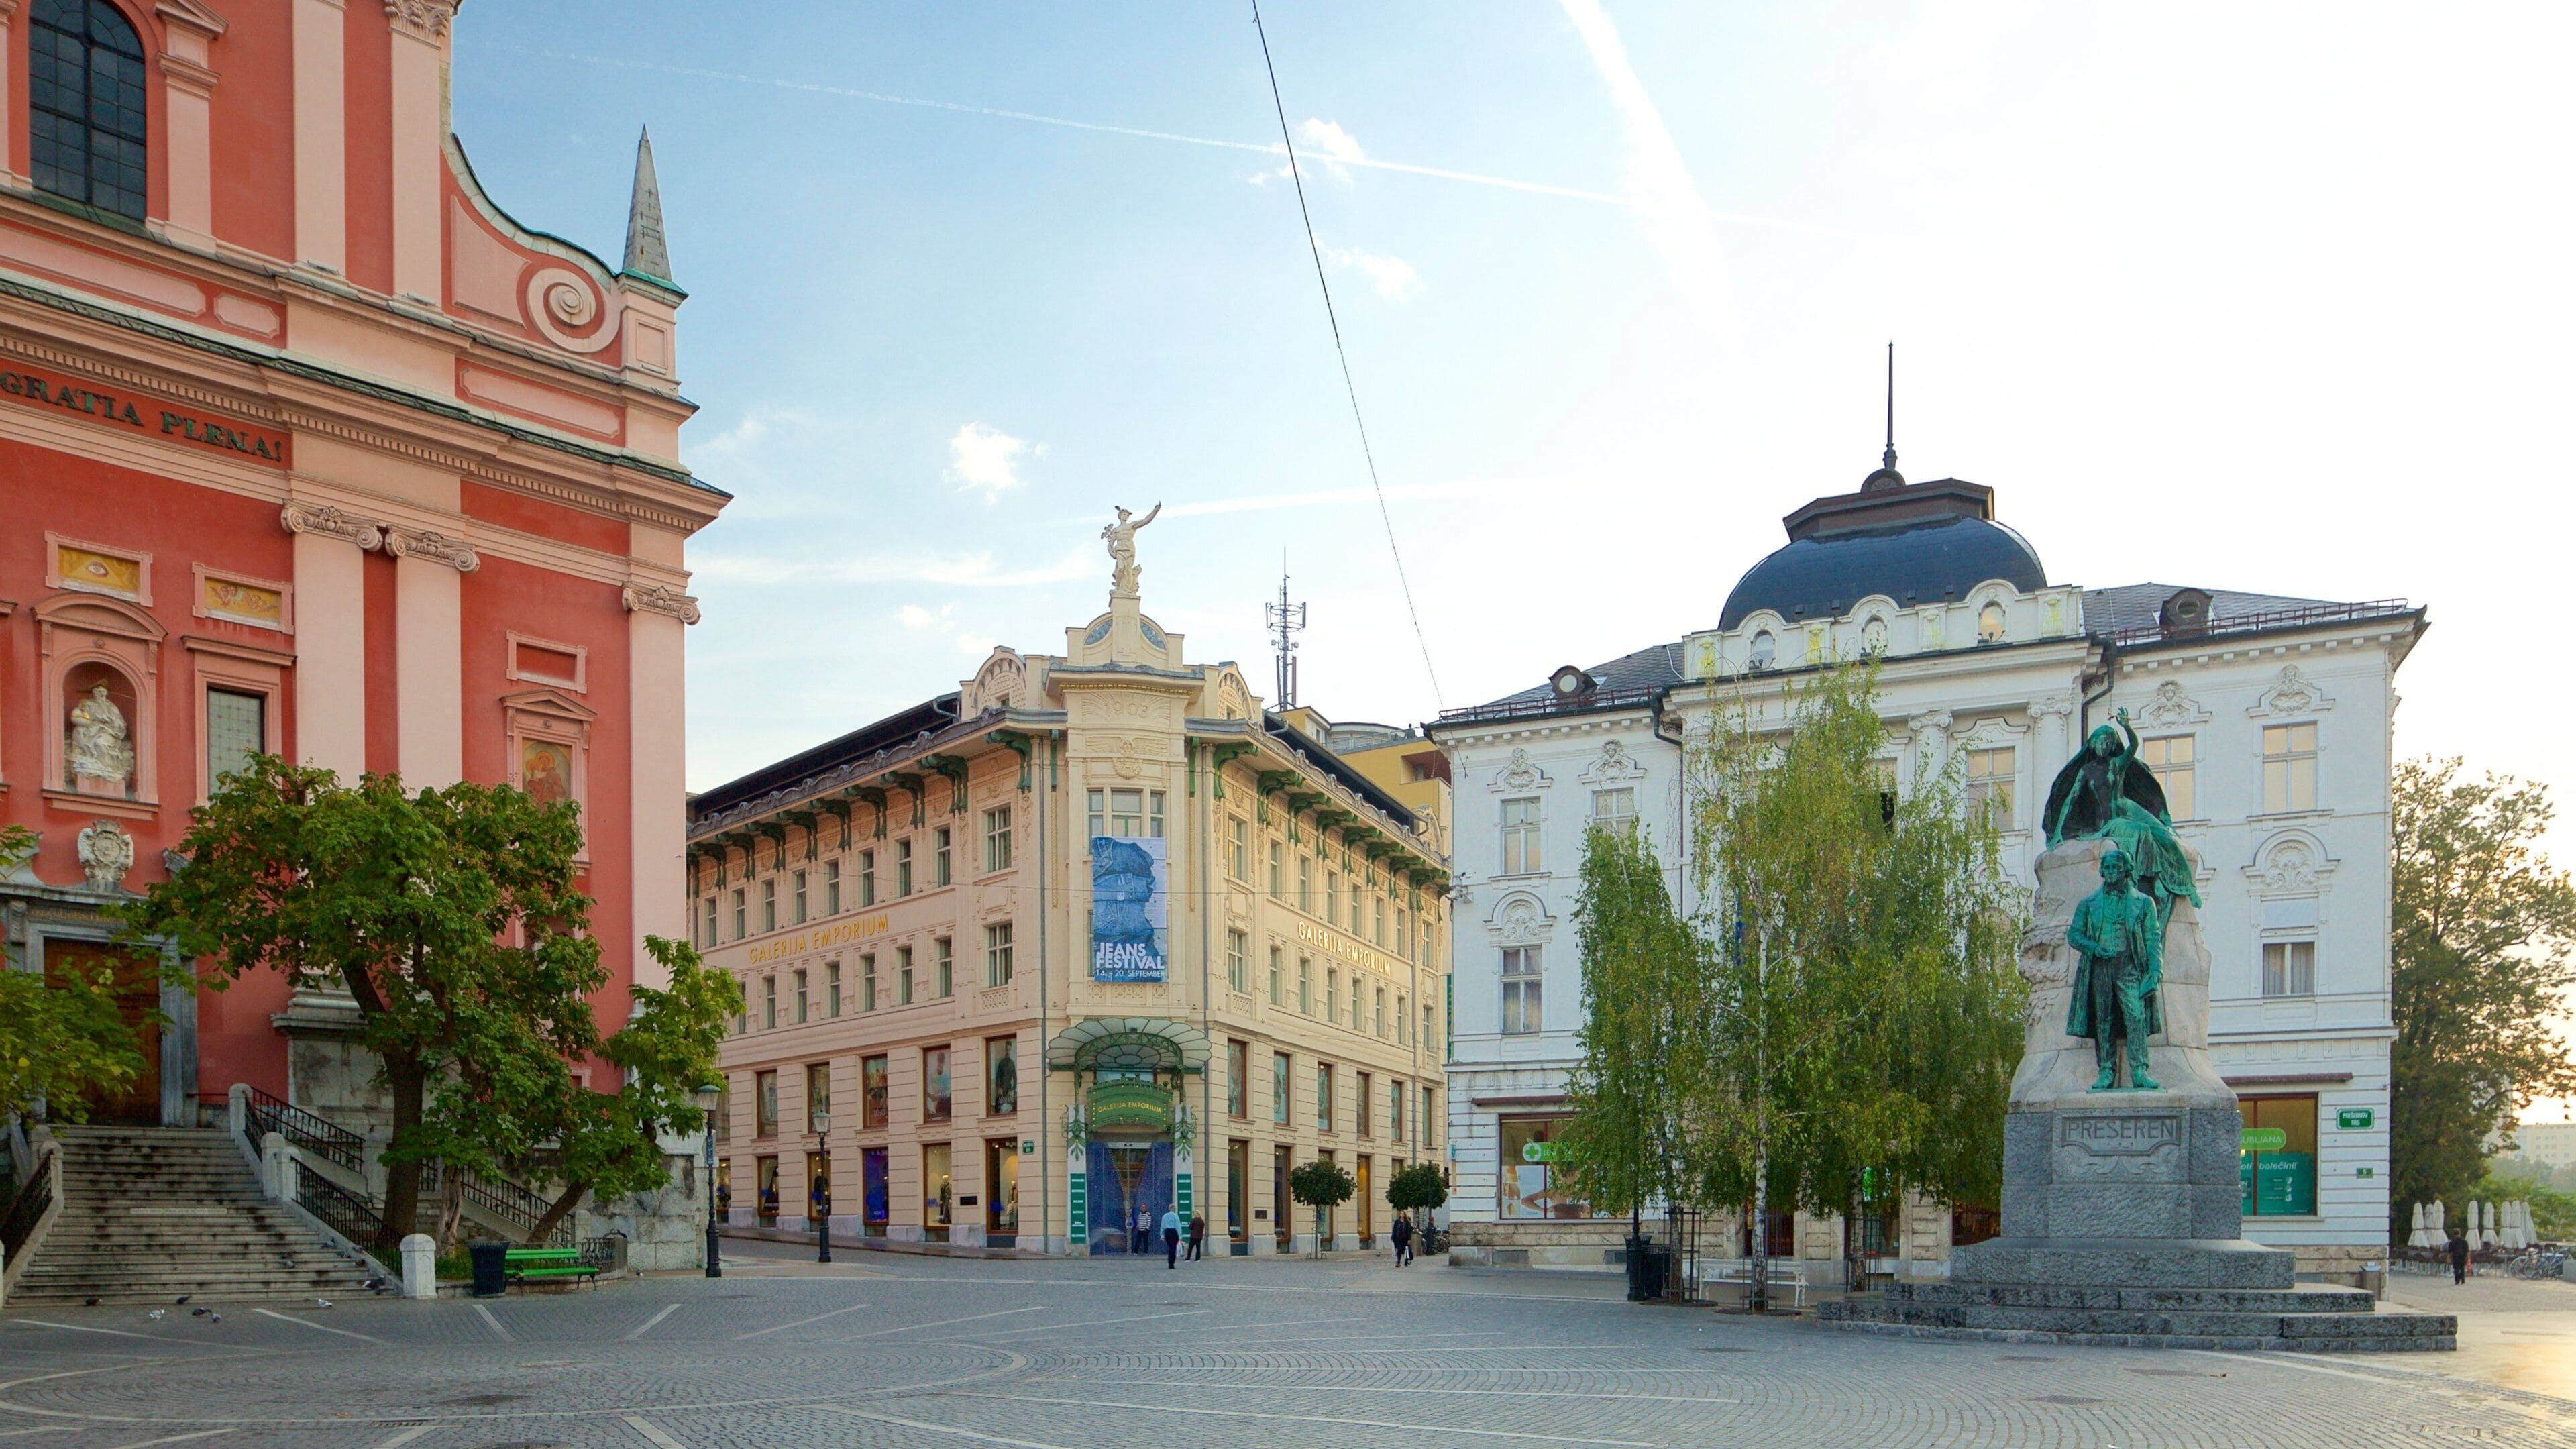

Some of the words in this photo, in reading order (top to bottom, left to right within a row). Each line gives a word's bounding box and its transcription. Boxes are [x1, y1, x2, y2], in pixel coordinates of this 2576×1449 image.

[0, 371, 144, 426] GRATIA
[160, 411, 282, 462] PLENA!
[749, 935, 807, 964] GALERIJA
[812, 914, 888, 949] EMPORIUM
[1099, 943, 1146, 957] JEANS
[1298, 920, 1342, 955] GALERIJA
[1346, 942, 1391, 976] EMPORIUM
[1096, 951, 1165, 969] FESTIVAL
[1097, 1102, 1127, 1112] GALERIJA
[1128, 1102, 1162, 1114] EMPORIUM
